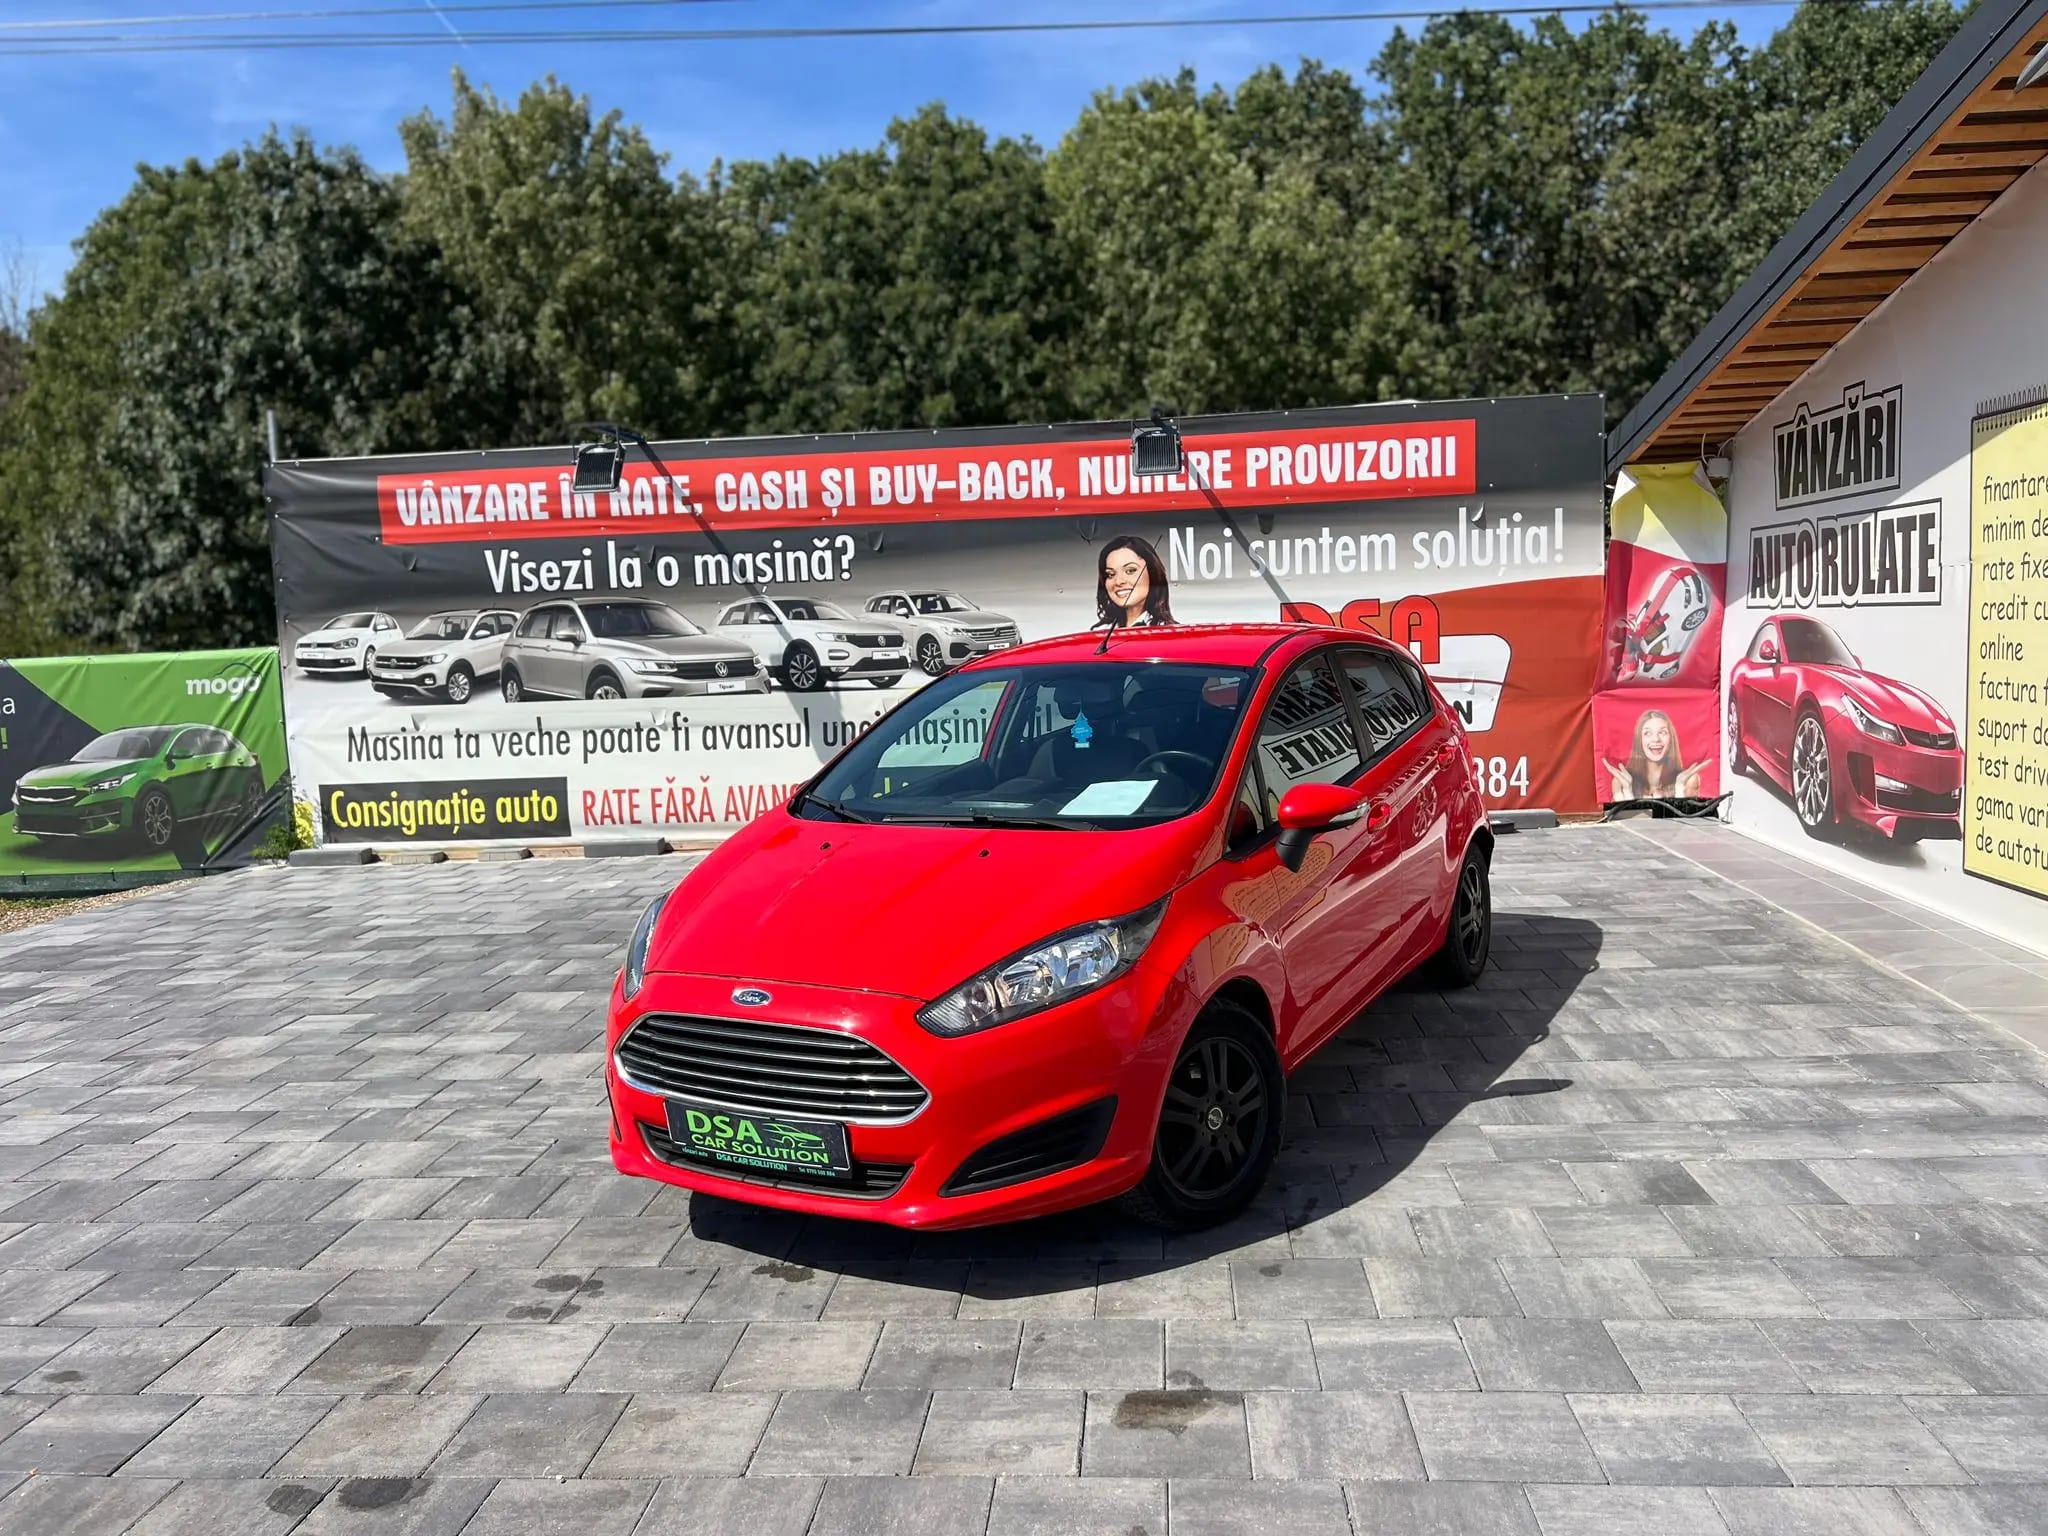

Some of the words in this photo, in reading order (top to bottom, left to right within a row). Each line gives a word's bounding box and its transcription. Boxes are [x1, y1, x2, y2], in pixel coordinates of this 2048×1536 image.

[1777, 395, 1897, 499] VÂNZĂRI
[396, 480, 549, 526] VÂNZARE
[609, 474, 702, 517] RATE,
[715, 469, 808, 513] CASH
[821, 467, 855, 517] ȘI
[870, 458, 1066, 504] BUY-BACK,
[1246, 436, 1456, 487] PROVIZORII
[1169, 526, 1233, 581] Noi
[1248, 526, 1396, 577] suntem
[1413, 506, 1564, 576] soluția!
[1982, 514, 2026, 543] minim
[484, 547, 594, 593] Visezi
[607, 541, 643, 589] la
[657, 555, 679, 587] o
[694, 534, 856, 593] mașină?
[1751, 530, 1814, 599] AUTO
[1821, 512, 1936, 597] RULATE
[1982, 557, 2015, 581] rate
[1981, 593, 2028, 621] credit
[1980, 633, 2024, 661] online
[186, 675, 262, 702] mogo
[1979, 671, 2037, 703] factura
[348, 726, 443, 762] Masina
[455, 727, 480, 758] ta
[491, 716, 570, 756] veche
[583, 720, 661, 764] poate
[672, 711, 690, 751] fi
[703, 707, 810, 751] avansul
[1977, 717, 2027, 747] suport
[1978, 751, 2009, 780] test
[331, 789, 486, 836] Consignație
[496, 789, 558, 823] auto
[583, 787, 642, 826] RATE
[651, 775, 716, 824] FĂRĂ
[1976, 794, 2013, 821] gama
[1976, 826, 1993, 854] de
[685, 1109, 763, 1144] DSA
[691, 1134, 728, 1150] CAR
[738, 1141, 829, 1164] SOLUTION
[716, 1153, 733, 1163] DSA
[733, 1156, 749, 1166] CAR
